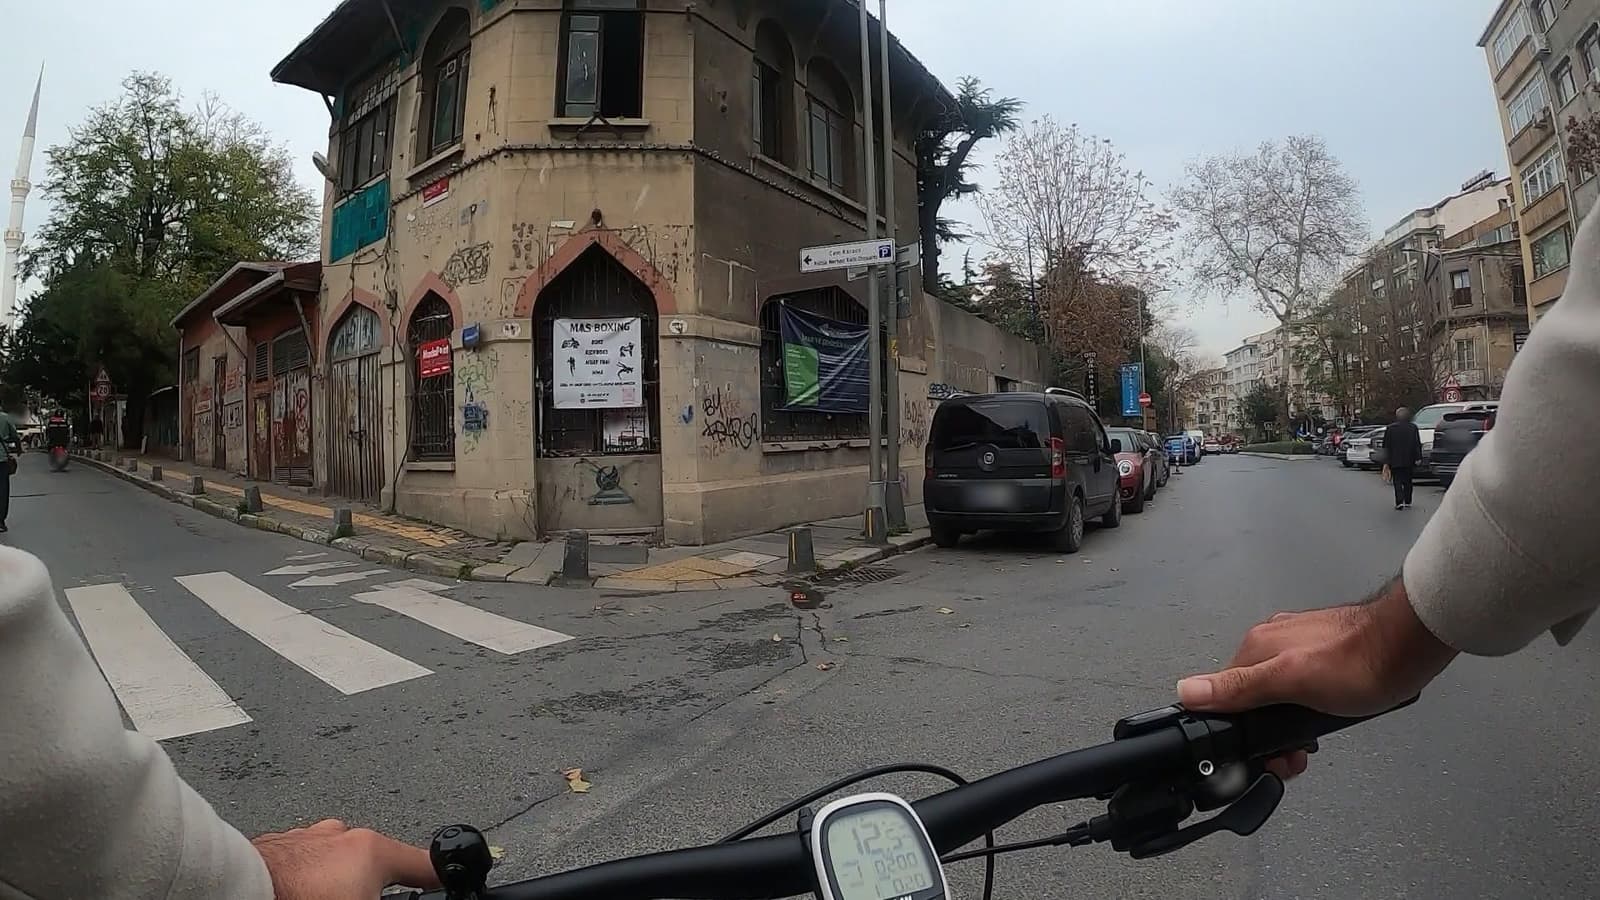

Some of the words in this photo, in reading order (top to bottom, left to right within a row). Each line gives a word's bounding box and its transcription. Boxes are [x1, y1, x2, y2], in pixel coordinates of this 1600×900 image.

[570, 323, 592, 332] MAS
[594, 322, 630, 332] BOXING
[1447, 391, 1457, 400] 20
